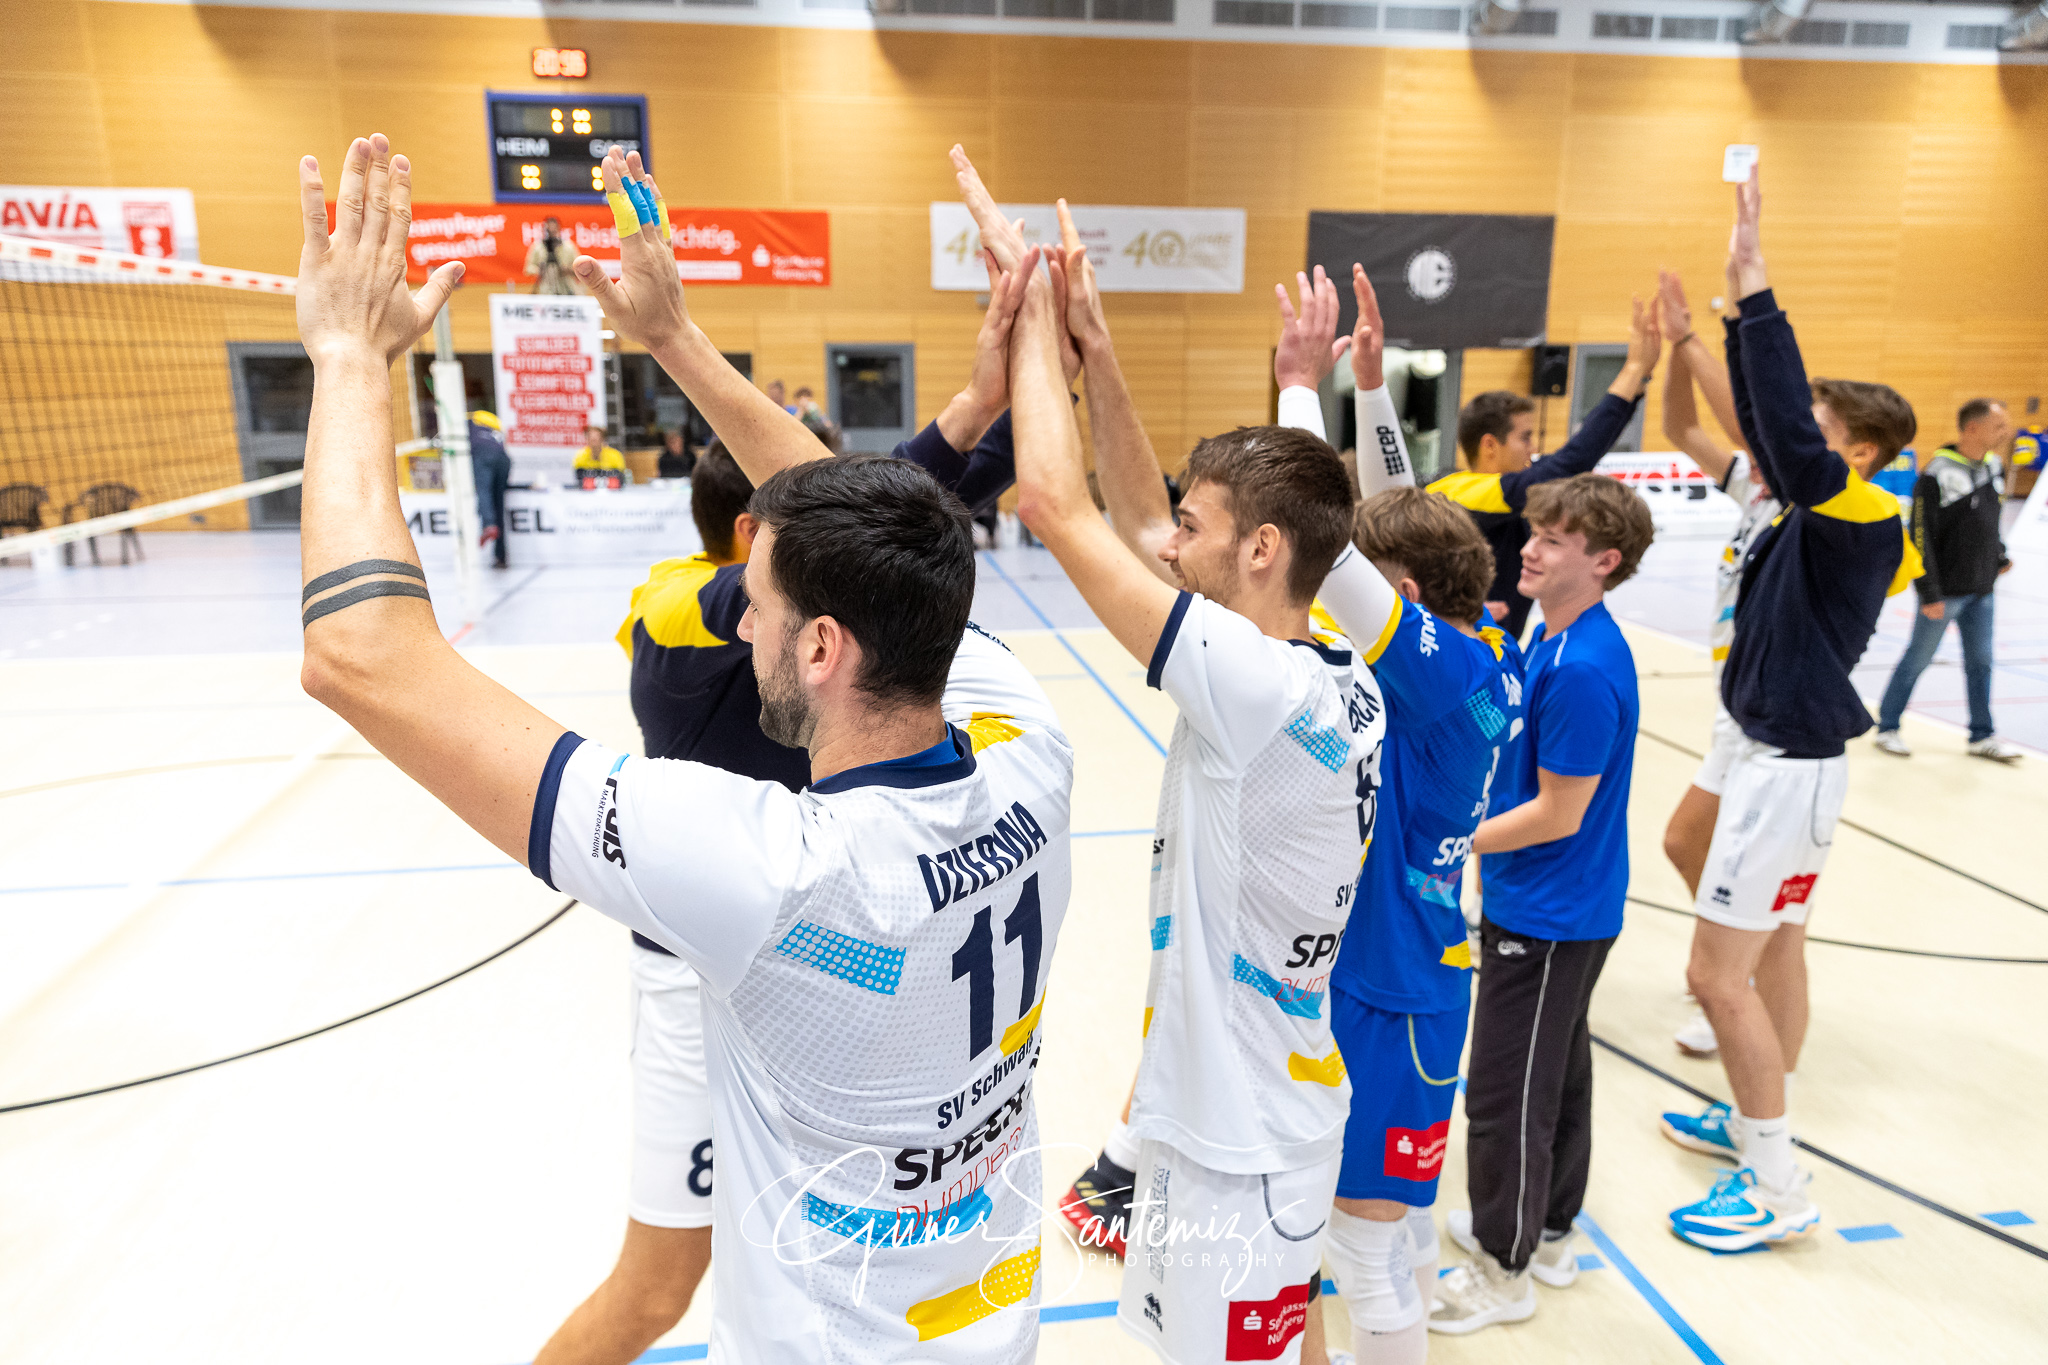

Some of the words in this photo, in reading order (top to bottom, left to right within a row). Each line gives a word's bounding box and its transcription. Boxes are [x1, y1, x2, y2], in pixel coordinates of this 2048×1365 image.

[592, 789, 609, 858] MARKTFORSCHUNG
[952, 871, 1043, 1062] 11
[937, 1091, 966, 1130] SV
[687, 1138, 713, 1197] 8
